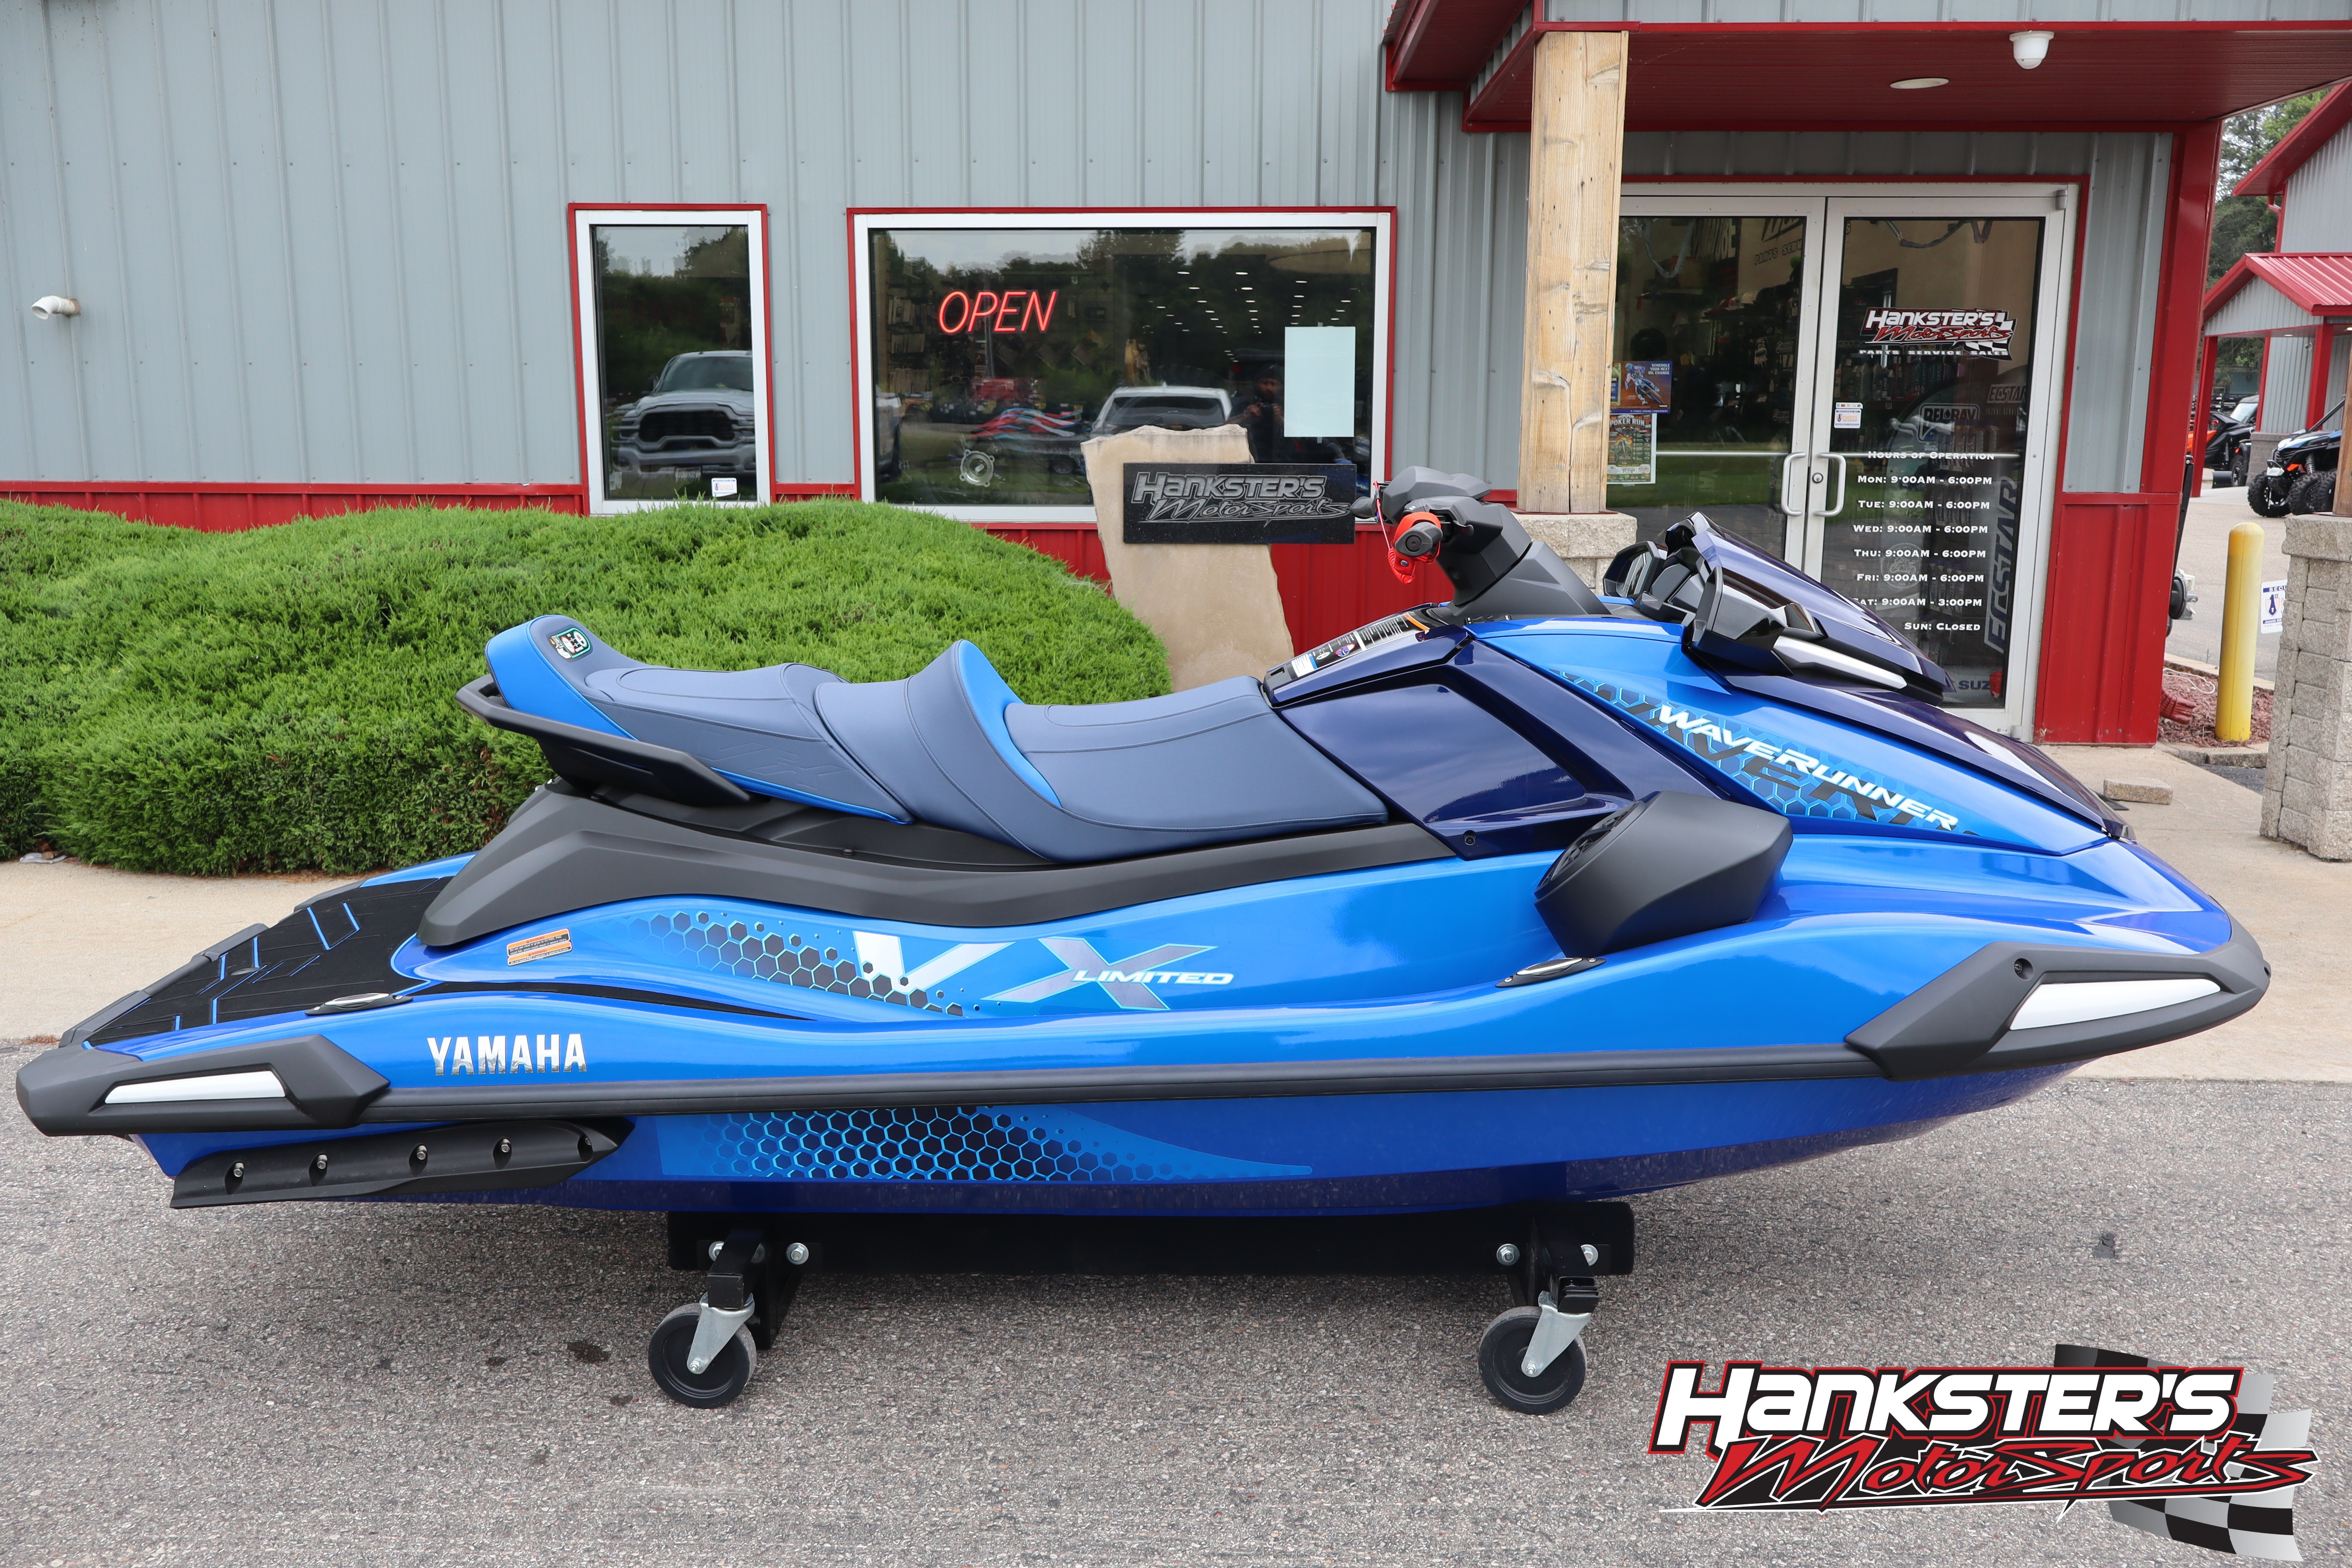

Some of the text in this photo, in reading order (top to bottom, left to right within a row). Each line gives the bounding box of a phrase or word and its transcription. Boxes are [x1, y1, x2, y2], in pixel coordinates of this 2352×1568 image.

[939, 290, 1058, 333] OPEN
[1610, 418, 1631, 427] POKER
[1632, 418, 1645, 426] RUN
[1659, 704, 1959, 831] WAVERUNNER
[1071, 969, 1234, 985] LIMITED
[427, 1034, 587, 1075] YAMAHA
